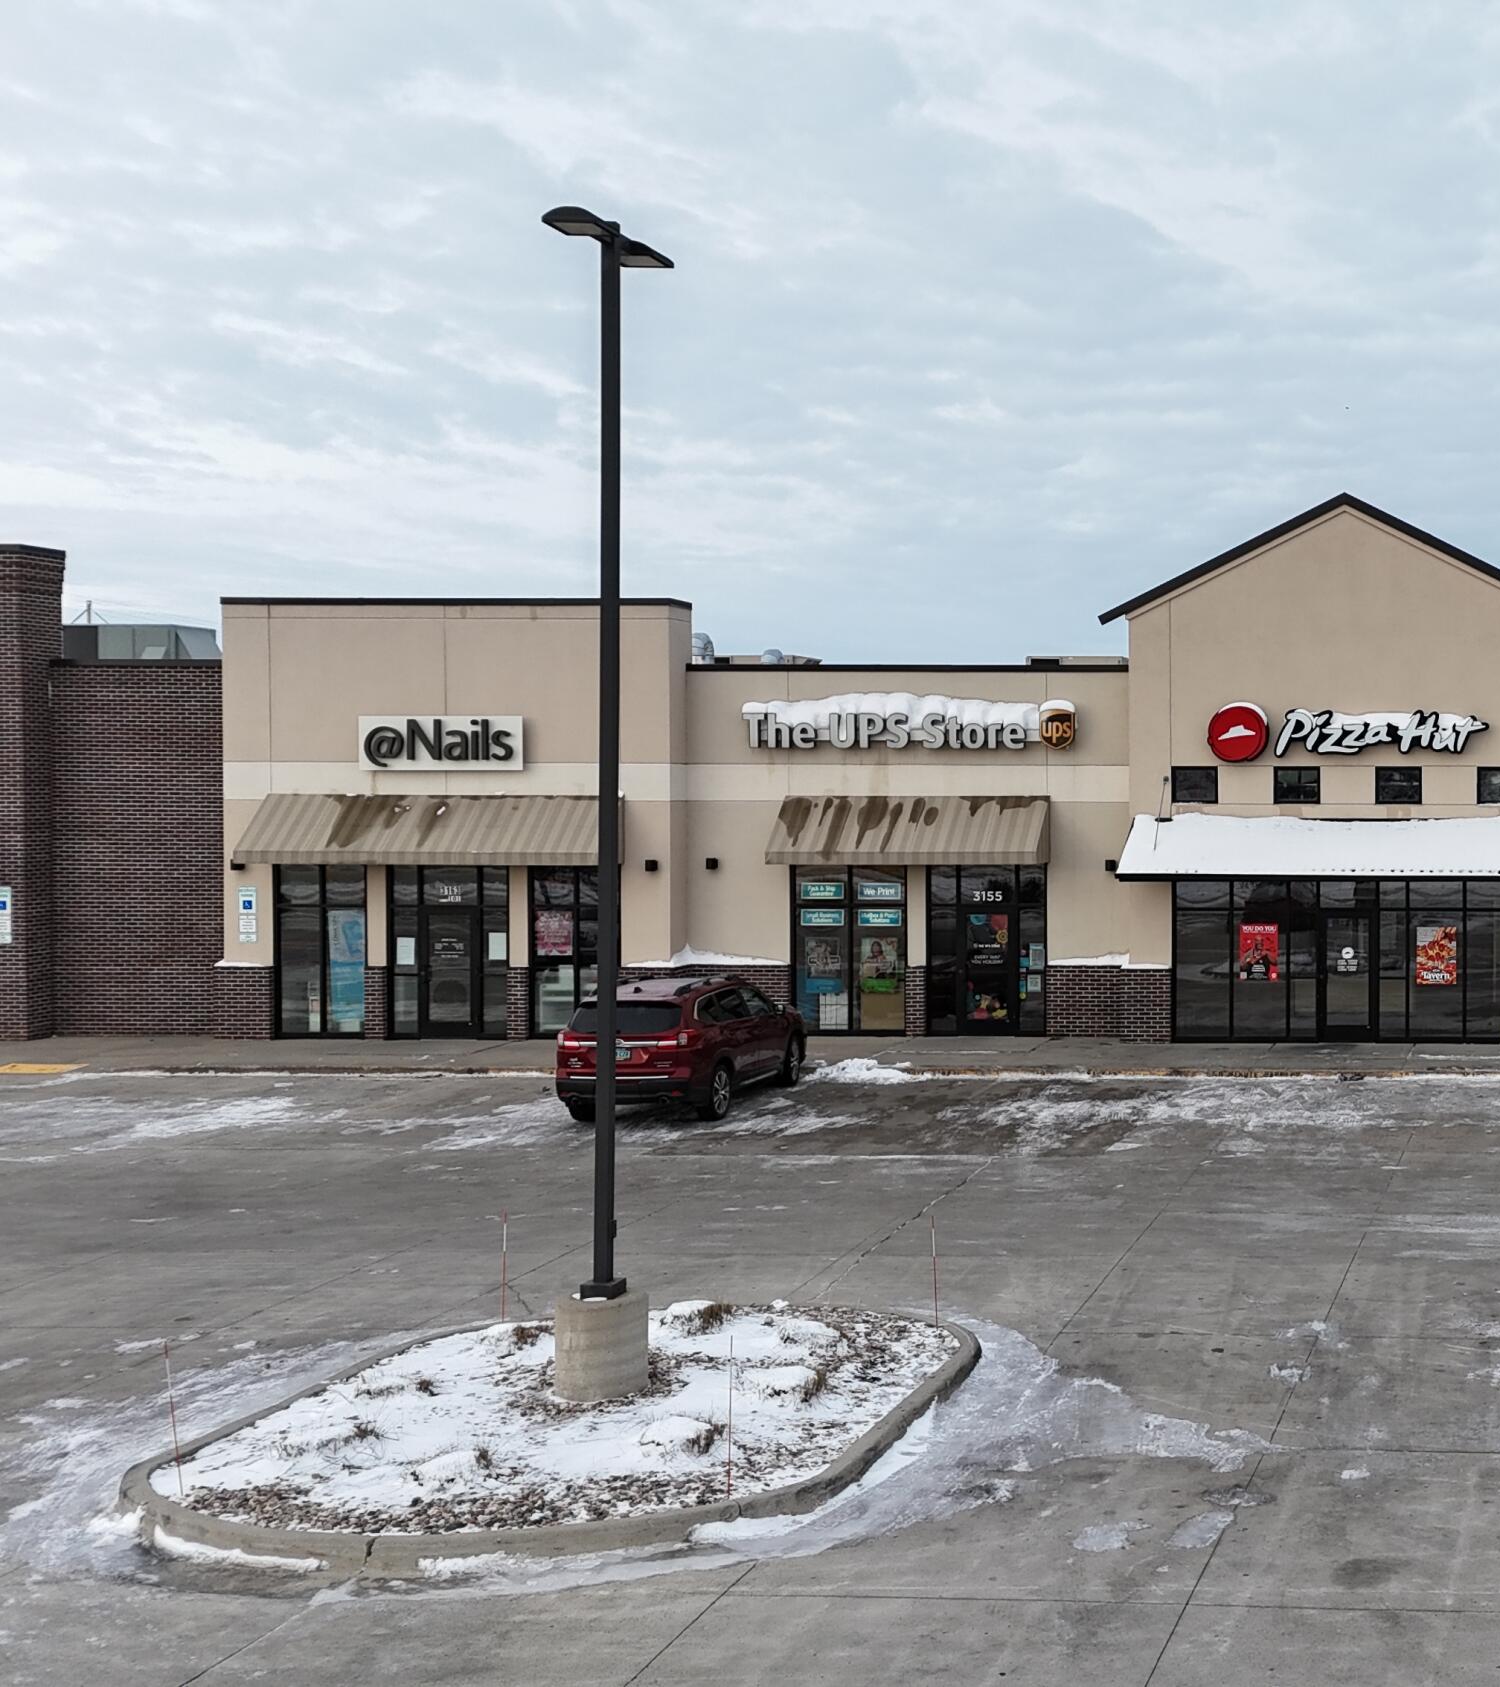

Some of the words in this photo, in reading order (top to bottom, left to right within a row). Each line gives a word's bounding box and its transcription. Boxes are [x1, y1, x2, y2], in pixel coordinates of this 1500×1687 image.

[364, 718, 514, 767] @Nails
[742, 712, 816, 750] The
[828, 712, 911, 750] UPS
[922, 712, 1026, 750] Store
[1042, 721, 1072, 744] ups
[1275, 709, 1392, 757] Pizza
[1397, 709, 1489, 754] Hut
[863, 887, 876, 896] We
[877, 887, 896, 896] Print
[973, 890, 1003, 902] 3155
[1422, 970, 1450, 980] Tavern
